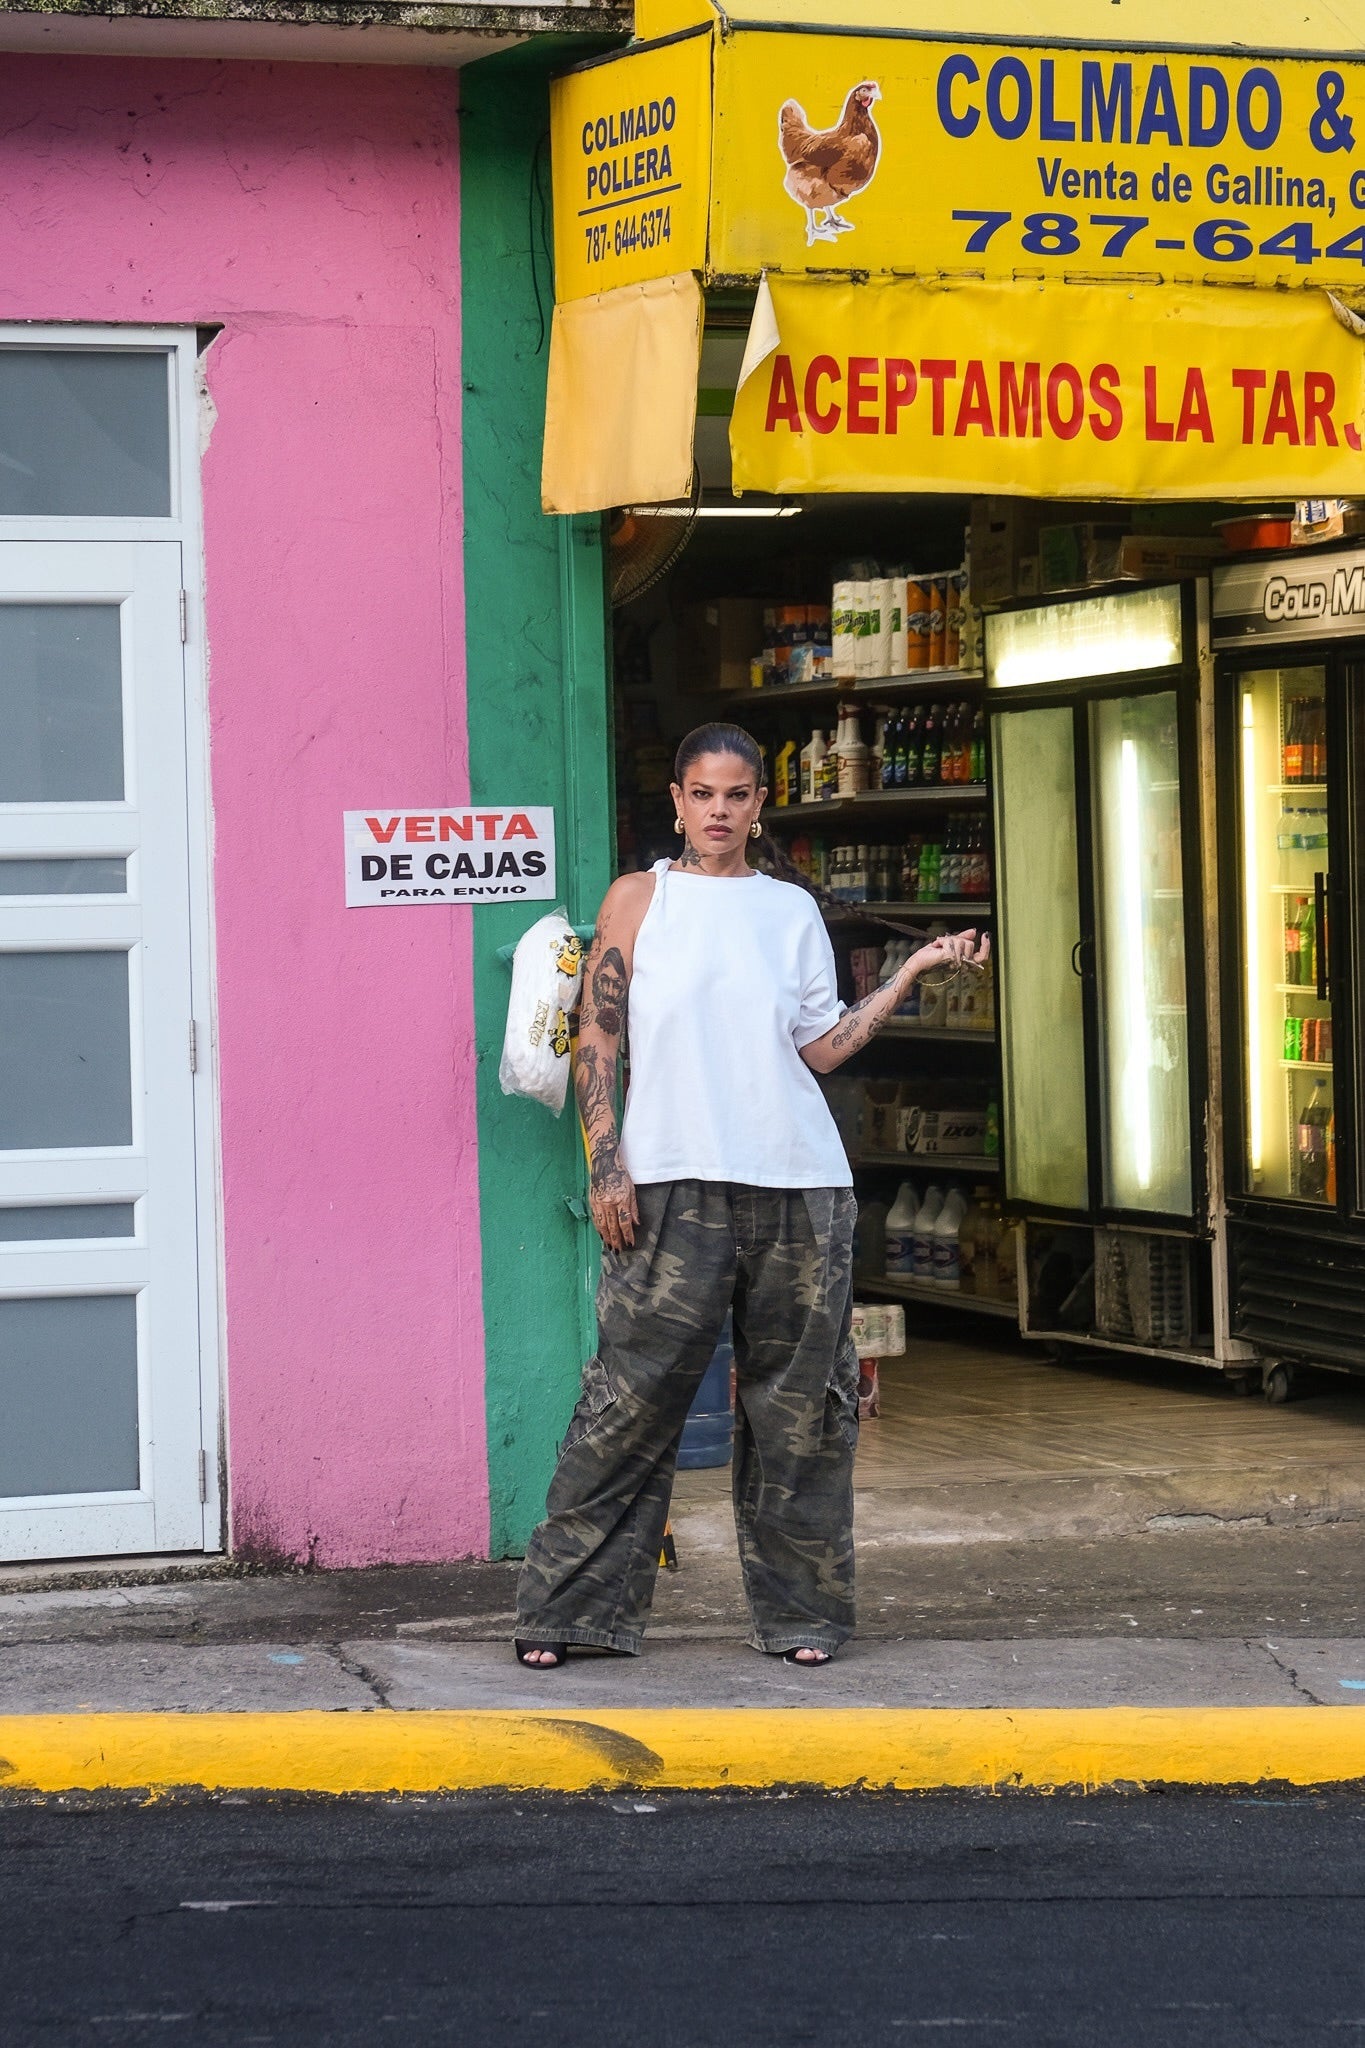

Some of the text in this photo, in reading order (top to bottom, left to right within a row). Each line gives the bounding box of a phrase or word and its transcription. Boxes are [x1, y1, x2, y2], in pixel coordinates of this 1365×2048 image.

[582, 96, 676, 155] COLMADO
[937, 55, 1355, 153] COLMADO &
[587, 144, 672, 200] POLLERA
[1037, 157, 1138, 201] Venta
[1152, 162, 1192, 203] de
[1206, 164, 1336, 218] Gallina,
[614, 206, 671, 257] 644-6374
[765, 354, 1123, 441] ACEPTAMOS
[1145, 365, 1215, 443] LA
[1263, 575, 1329, 624] COLD
[364, 813, 538, 843] VENTA
[361, 850, 547, 881] DE CAJAS
[380, 888, 446, 897] PARA
